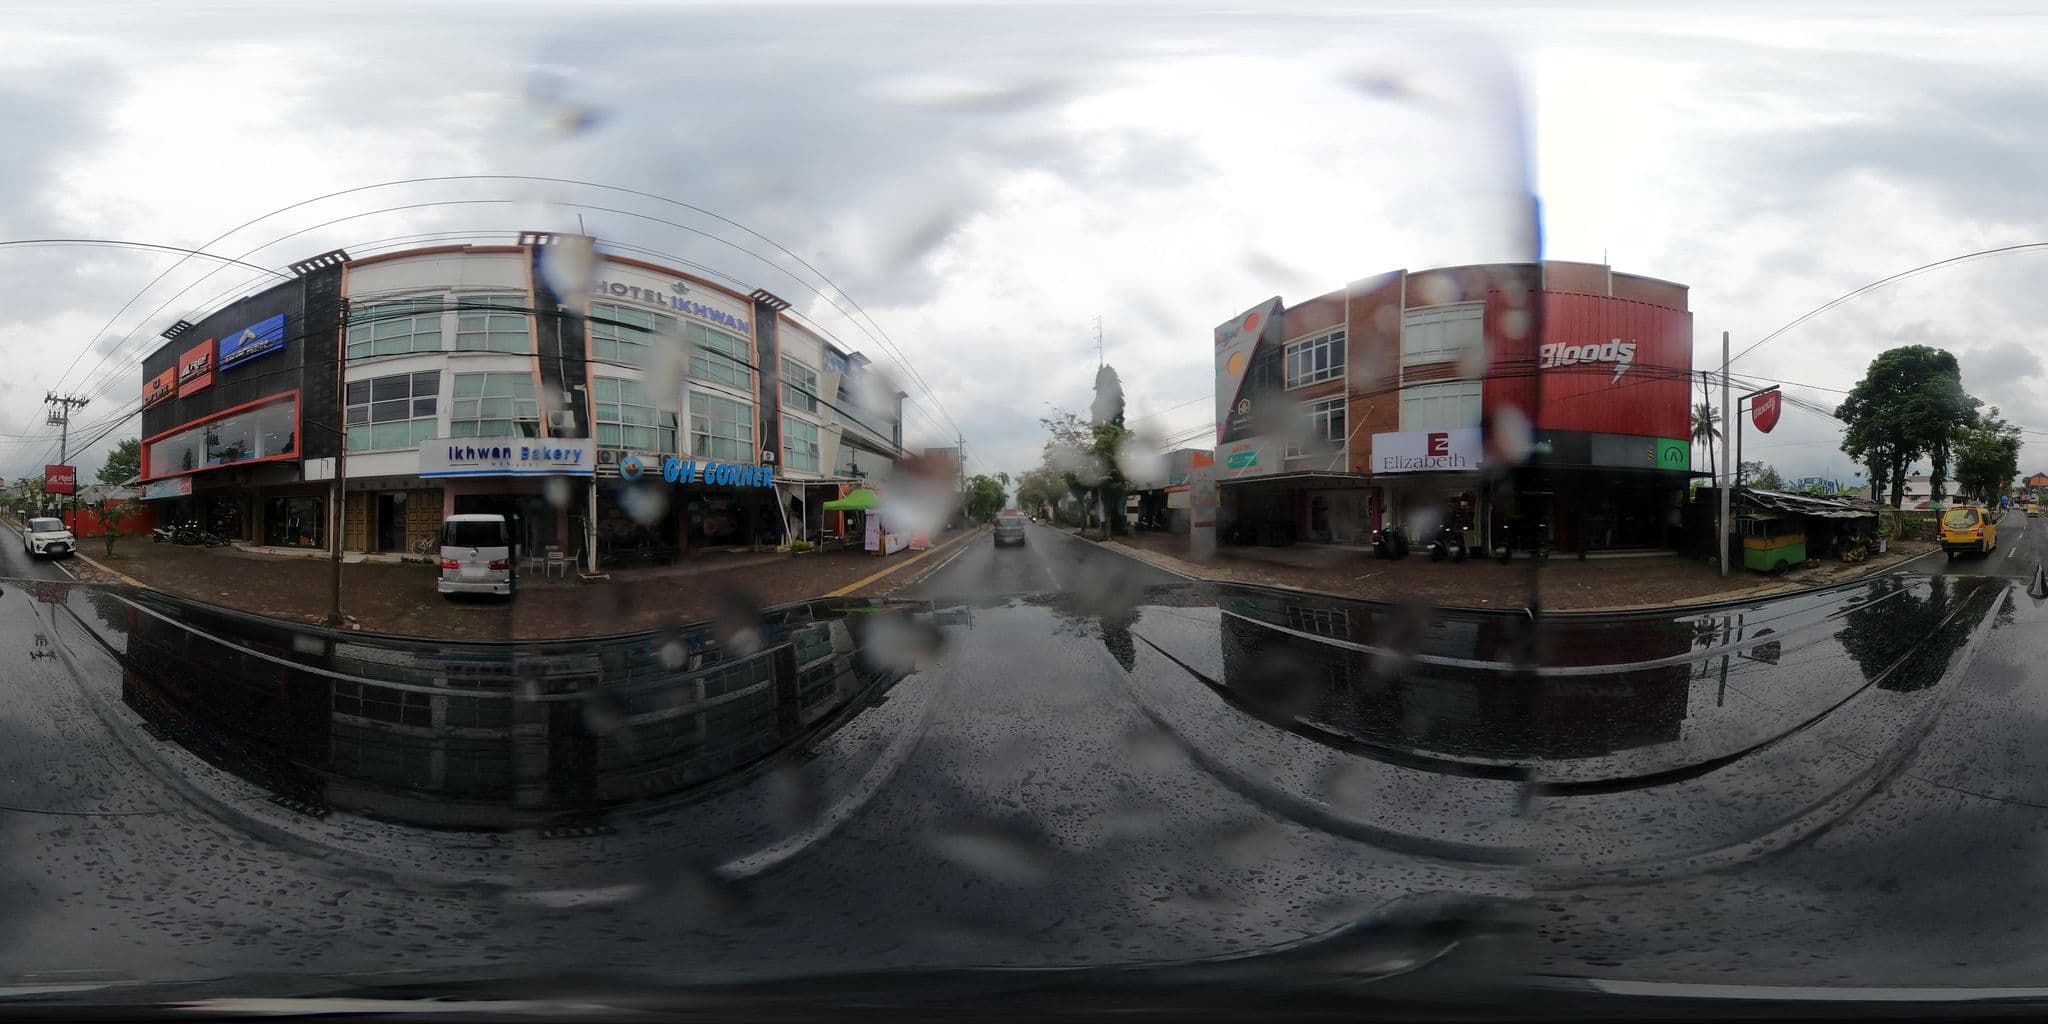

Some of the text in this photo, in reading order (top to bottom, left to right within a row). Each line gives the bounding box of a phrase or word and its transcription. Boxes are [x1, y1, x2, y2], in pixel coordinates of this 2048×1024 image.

[593, 279, 750, 334] HOTEL IKHWAN
[1540, 338, 1637, 384] Bloods
[1753, 396, 1776, 420] Bloods
[449, 446, 583, 463] Ikhwan Bakery
[1384, 453, 1466, 469] Elizabeth
[663, 457, 774, 488] GH CORNER
